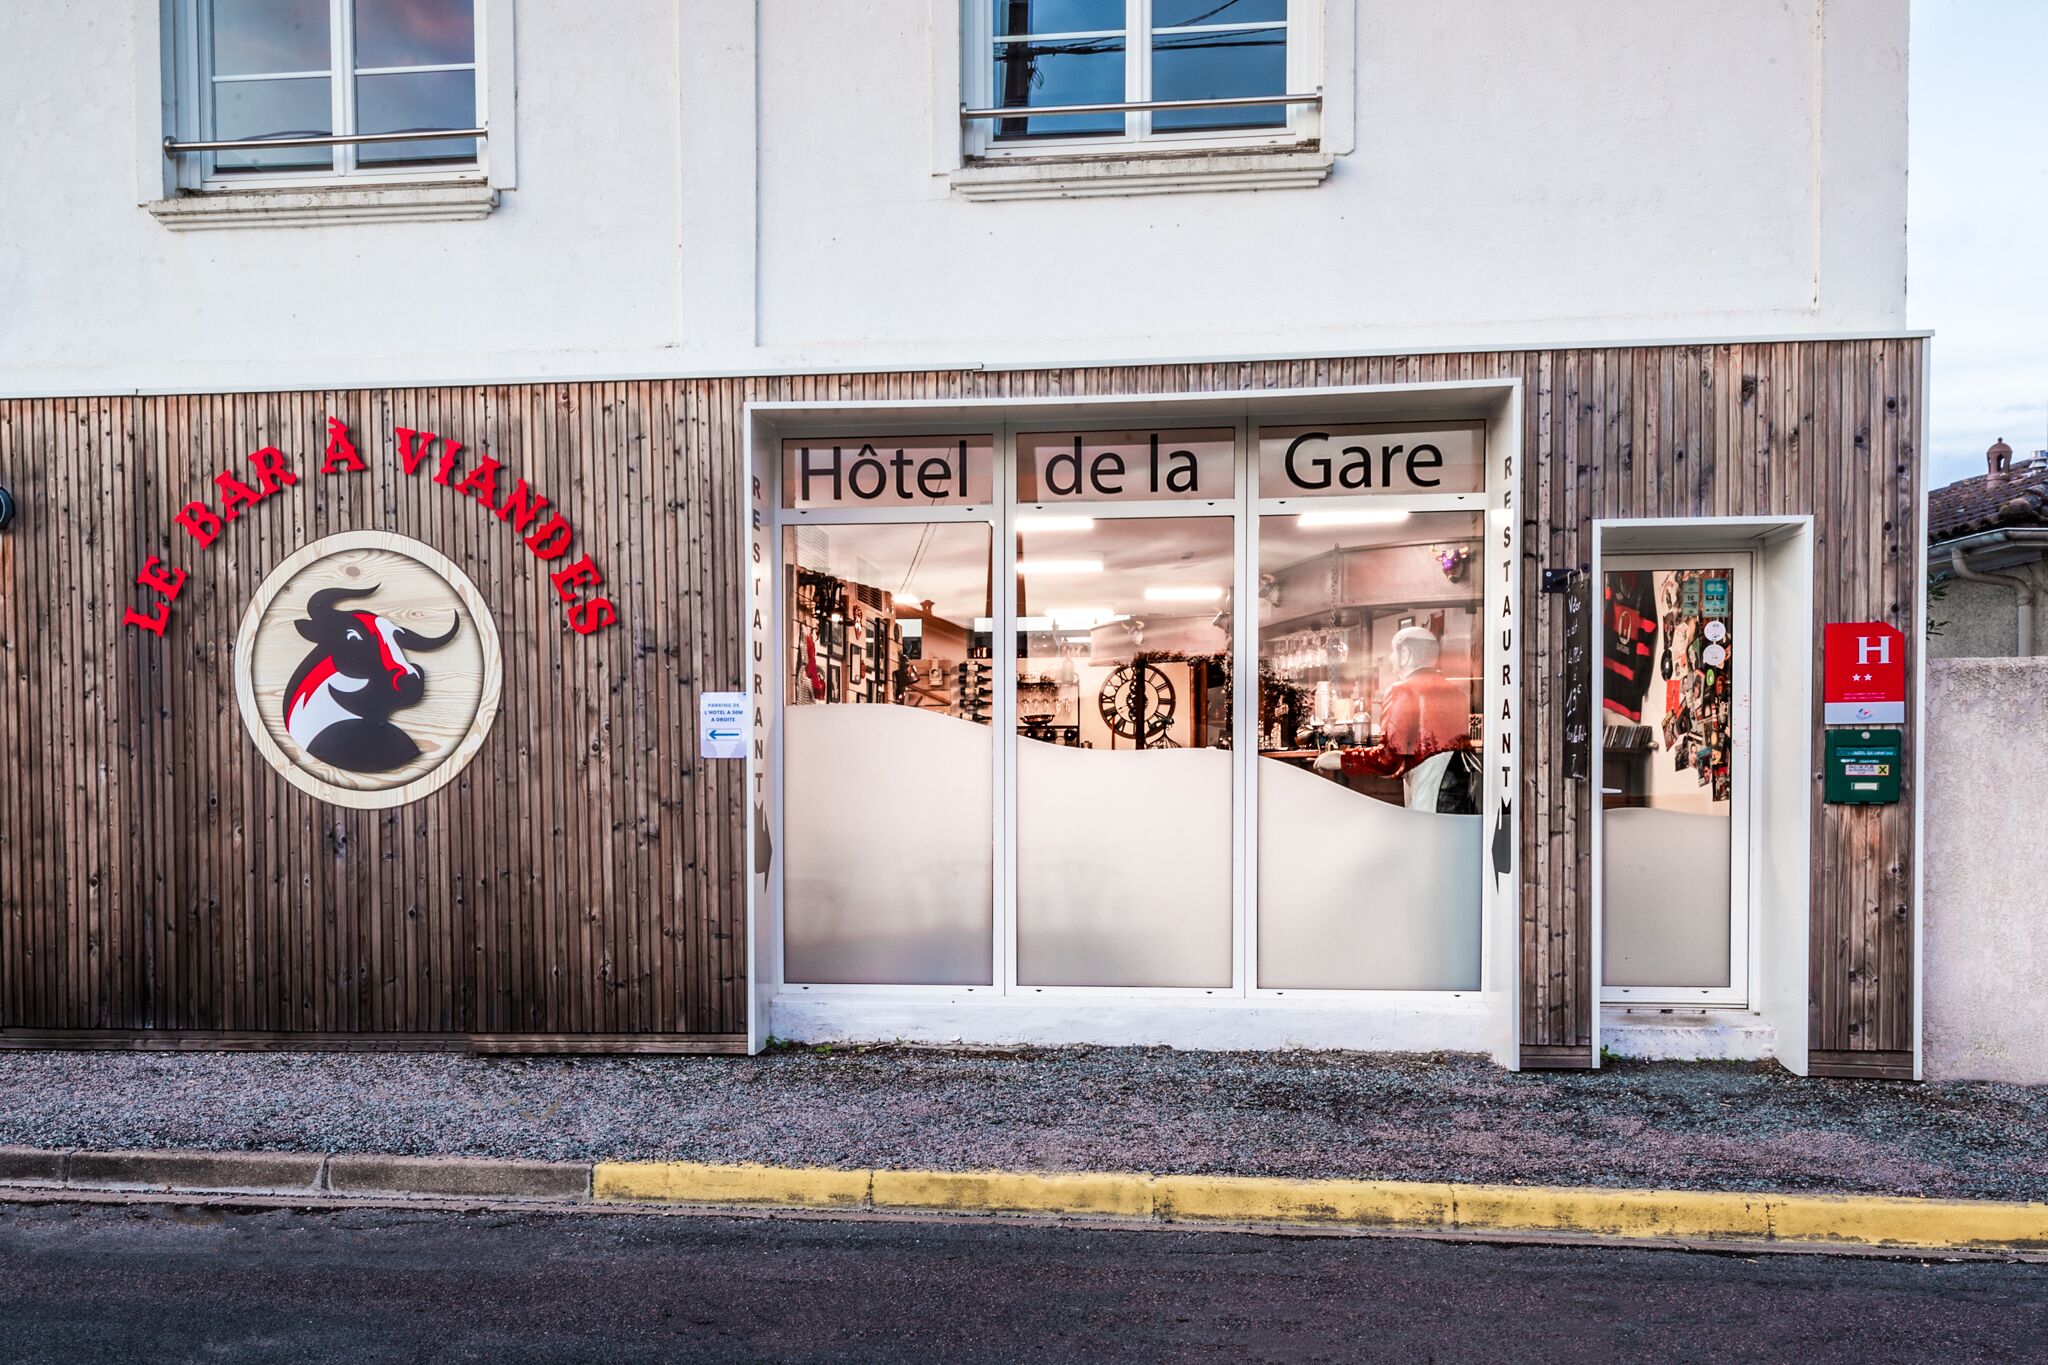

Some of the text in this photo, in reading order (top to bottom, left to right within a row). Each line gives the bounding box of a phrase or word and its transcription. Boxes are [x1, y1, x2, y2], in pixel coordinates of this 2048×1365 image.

[122, 417, 616, 638] LE BAR À VIANDES
[801, 432, 1443, 501] Hôtel de la Gare
[753, 475, 763, 793] RESTAURANT
[1501, 456, 1513, 788] RESTAURANT
[1855, 635, 1893, 665] H
